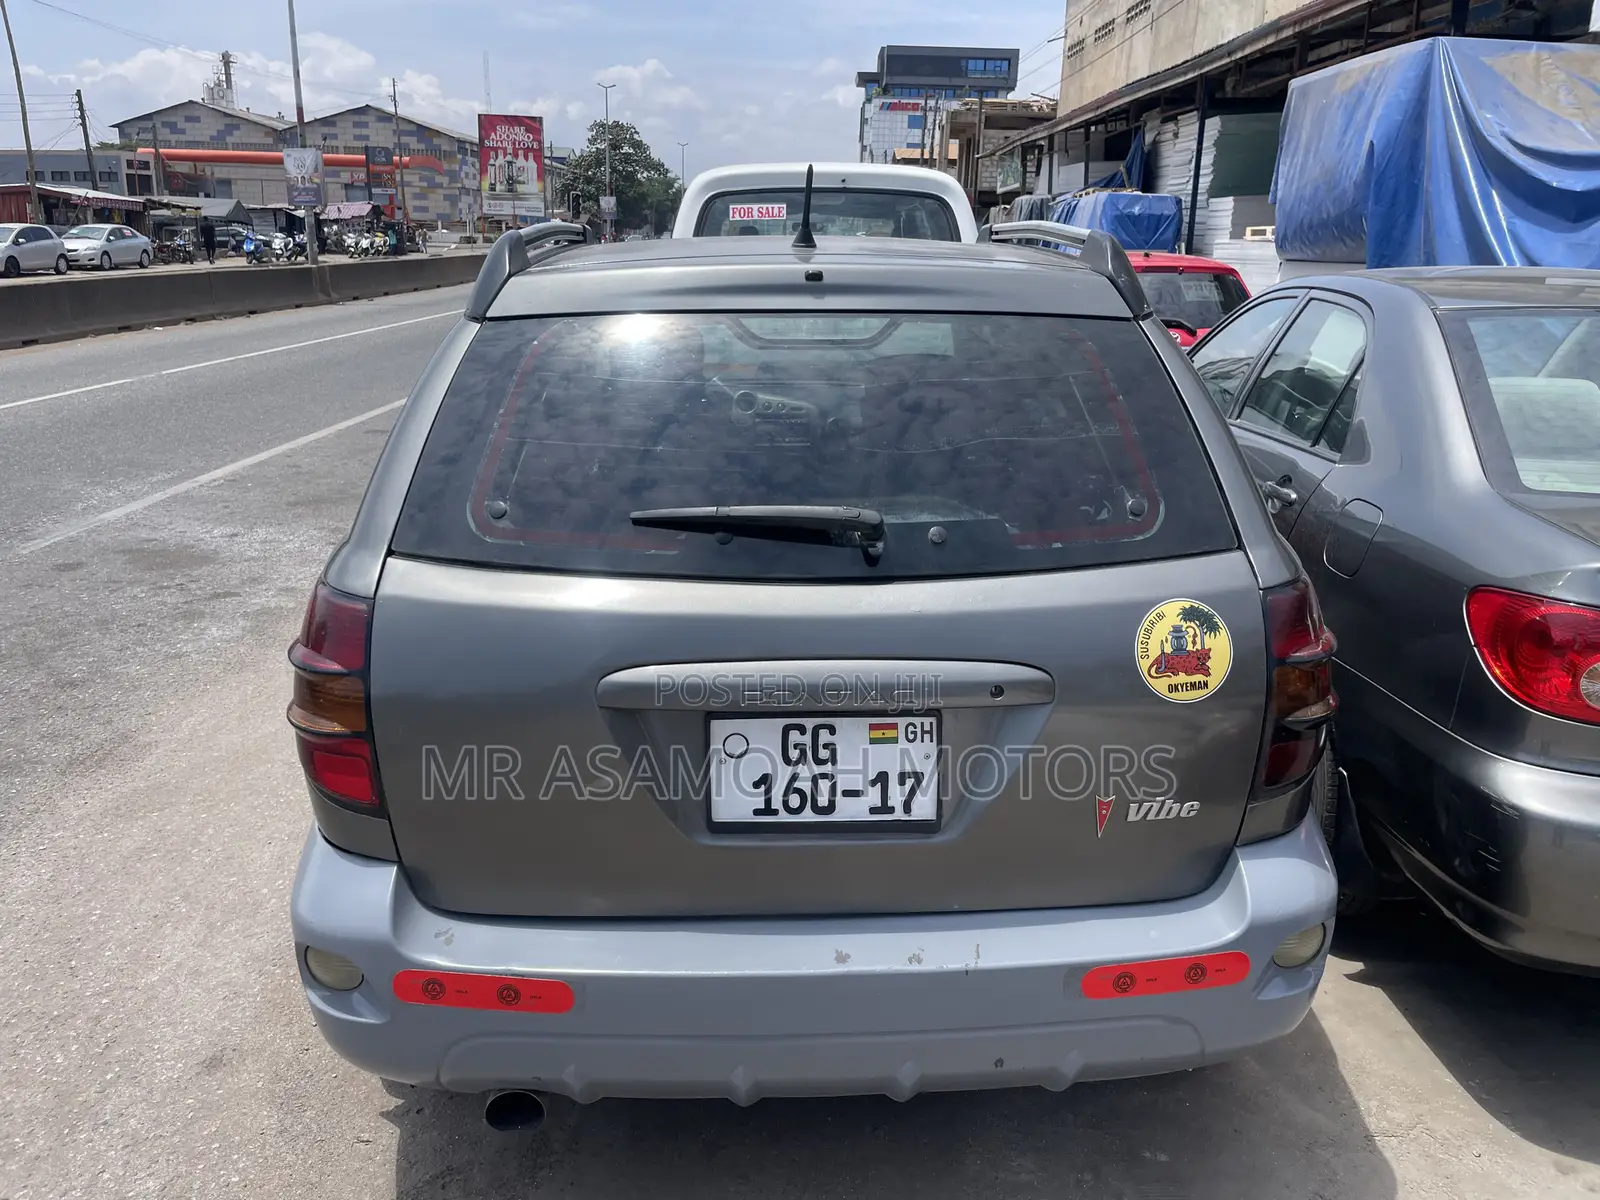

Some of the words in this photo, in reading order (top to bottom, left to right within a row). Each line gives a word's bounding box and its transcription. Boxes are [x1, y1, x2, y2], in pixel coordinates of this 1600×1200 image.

[496, 125, 526, 134] SHARE
[489, 132, 533, 142] ADONKO
[484, 140, 514, 148] SHARE
[515, 140, 540, 149] LOVE
[731, 206, 754, 219] FOR
[757, 206, 785, 219] SALE
[1140, 610, 1167, 660] SUSUBIRIBI
[1167, 680, 1209, 694] OKYEMAN
[904, 721, 934, 744] GH
[781, 723, 837, 767] GG
[752, 770, 925, 816] 160-17
